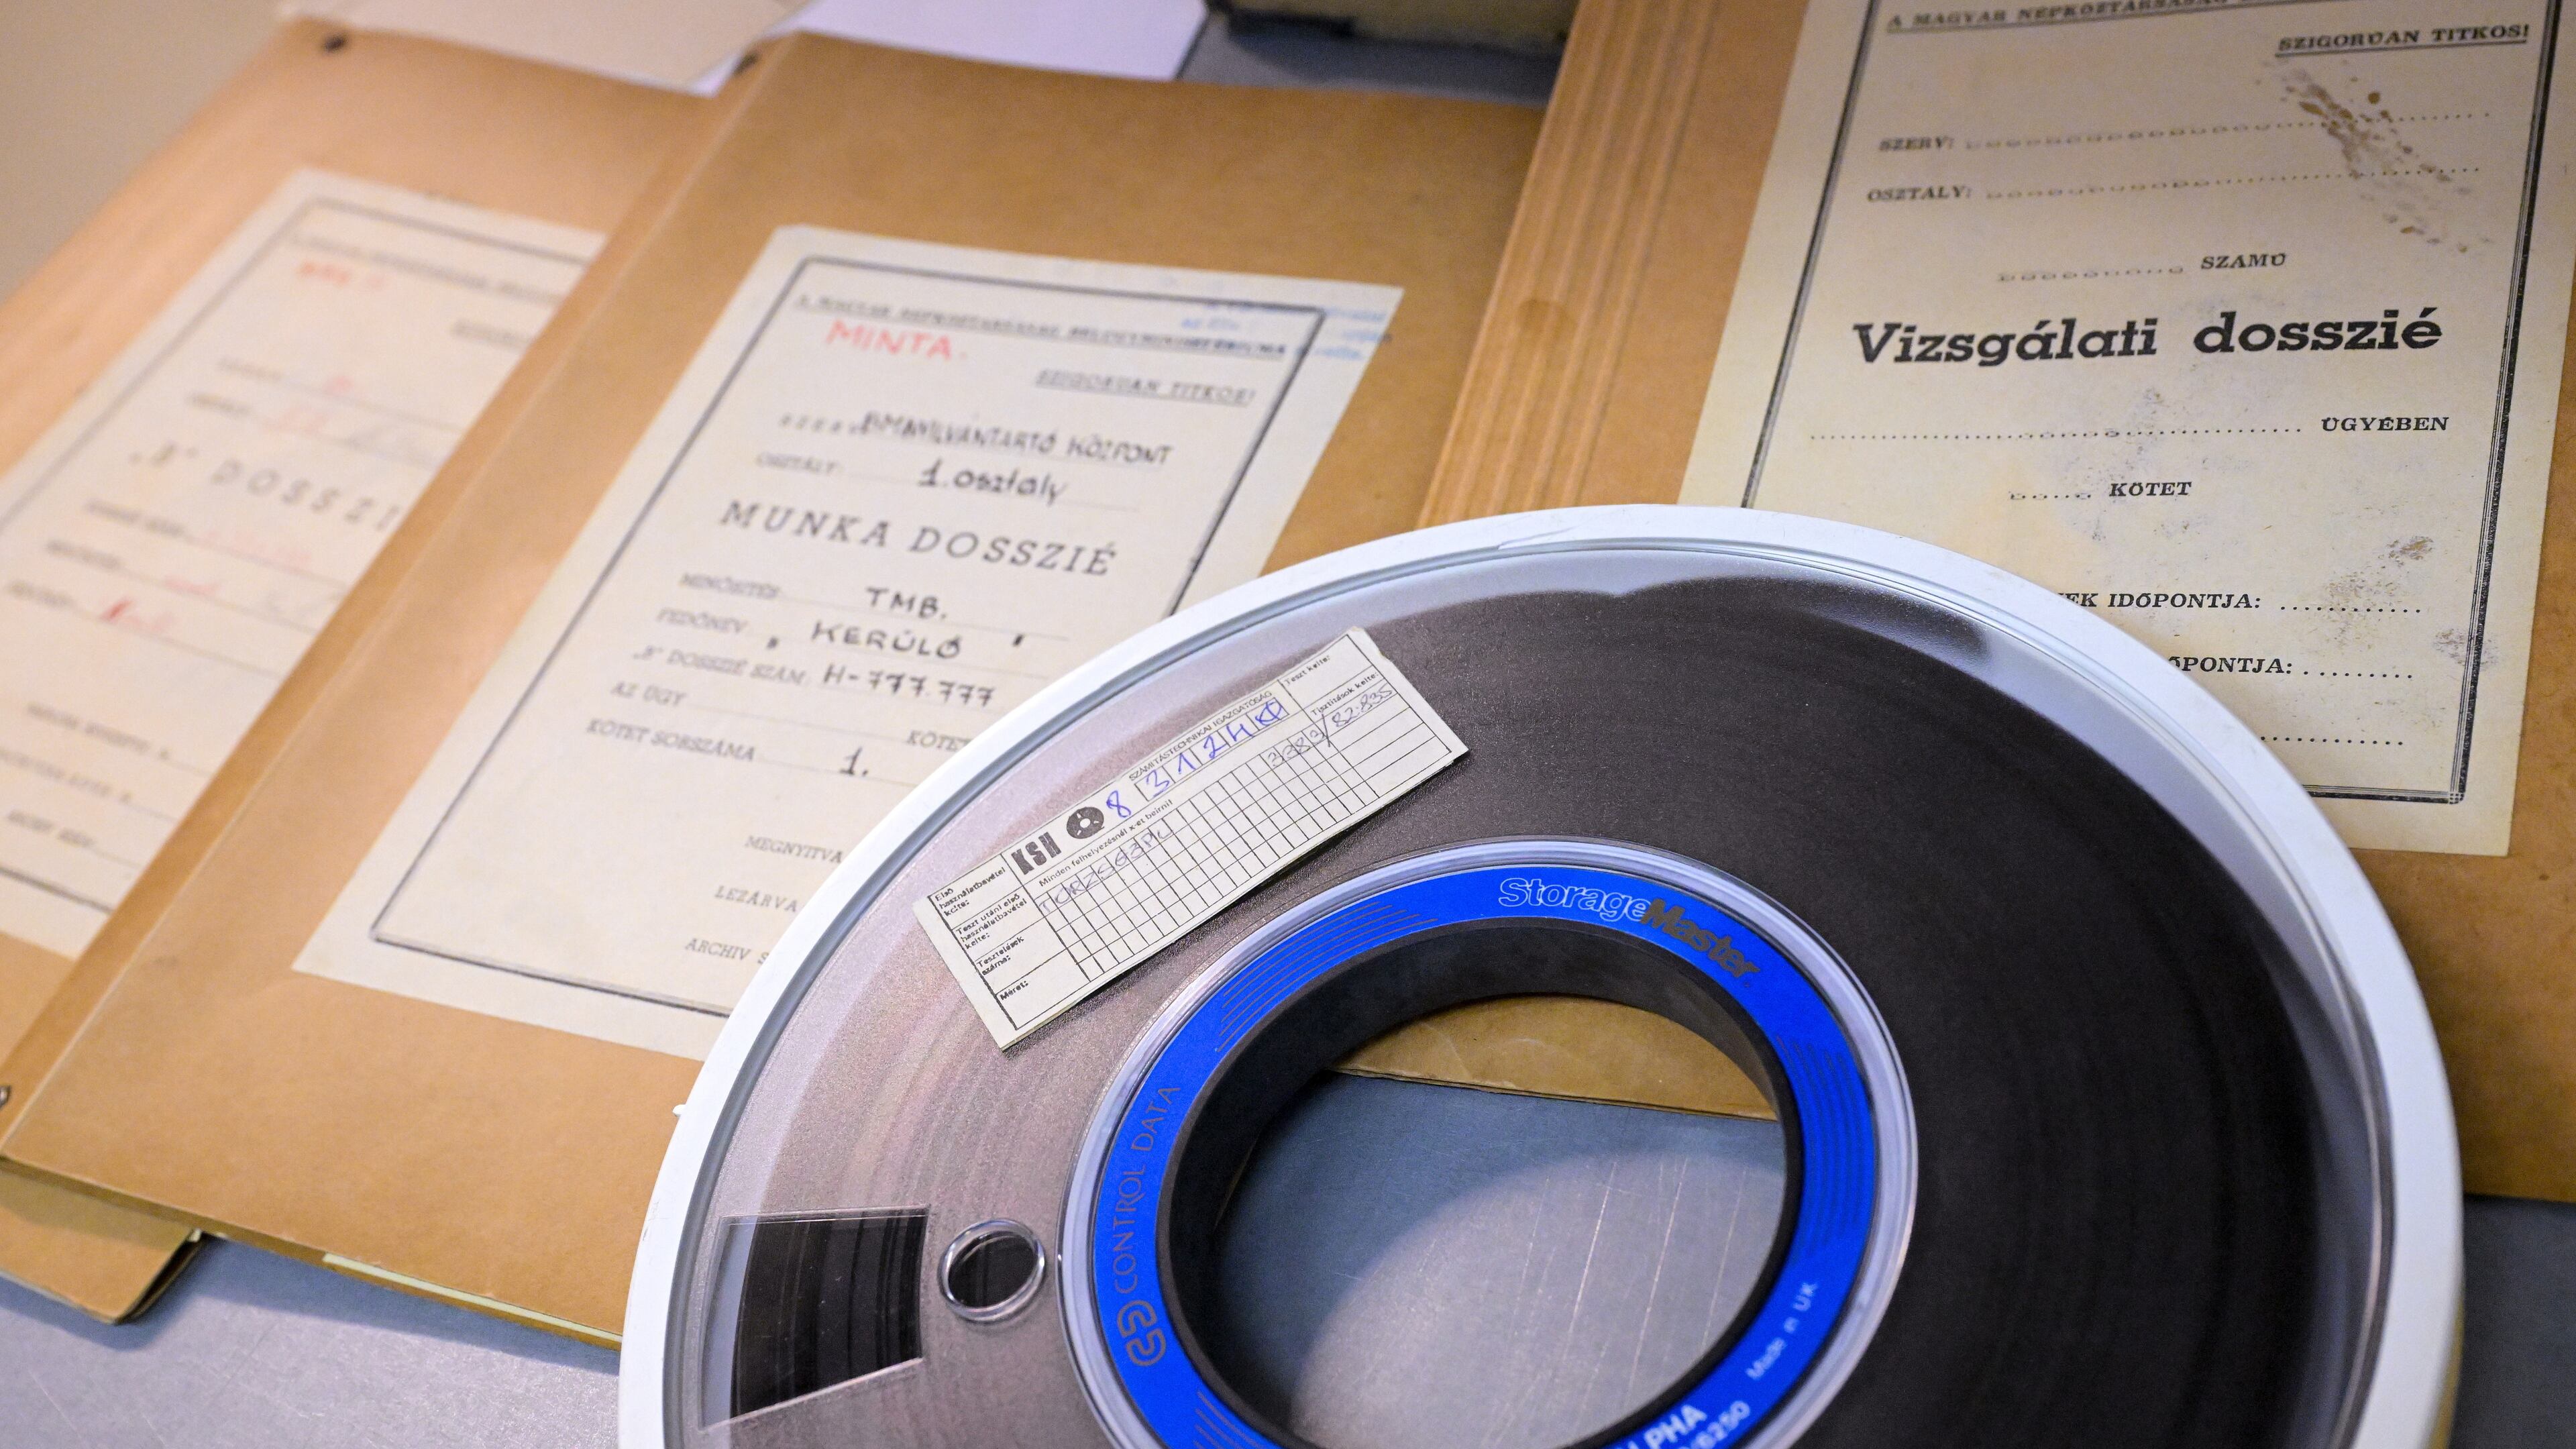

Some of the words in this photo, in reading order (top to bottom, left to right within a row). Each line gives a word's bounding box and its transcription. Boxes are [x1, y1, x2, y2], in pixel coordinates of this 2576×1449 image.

[1853, 317, 2158, 367] Vizsgálati
[2192, 307, 2443, 354] dosszié
[720, 500, 890, 547] MUNKA
[910, 526, 1116, 576] DOSSZIÉ
[866, 586, 947, 619] TMB.
[744, 835, 844, 864] MEGNYITVA
[1011, 831, 1062, 875] KSH
[1038, 865, 1071, 887] Minden
[955, 920, 979, 935] Teszt
[1112, 1165, 1146, 1294] CONTROL
[1130, 1083, 1181, 1152] DATA
[1792, 1281, 1819, 1311] UK
